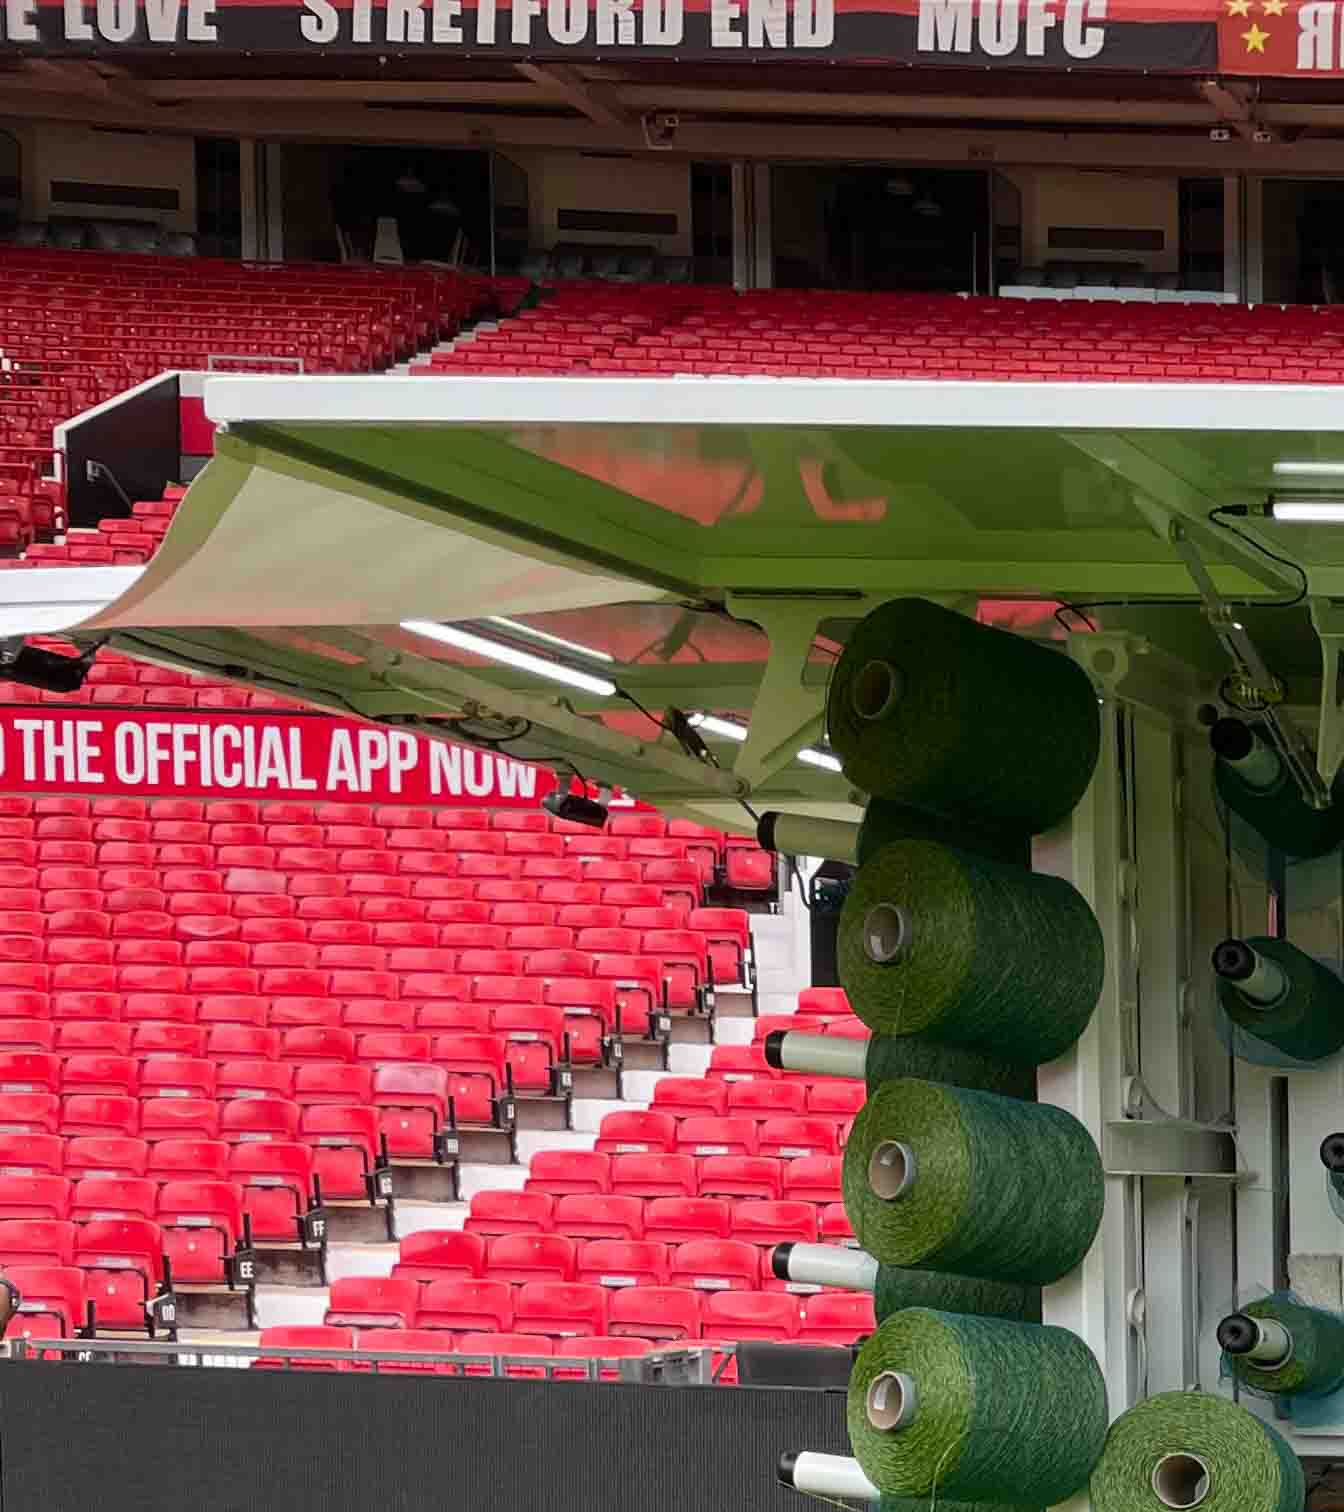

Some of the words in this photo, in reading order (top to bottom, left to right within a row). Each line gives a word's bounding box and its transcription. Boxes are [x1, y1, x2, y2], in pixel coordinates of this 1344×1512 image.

[64, 0, 217, 42] LOVE
[299, 0, 684, 47] STRETFORD
[711, 0, 835, 48] END
[917, 0, 1106, 58] MUFC
[13, 719, 105, 784] THE
[114, 720, 318, 791] OFFICIAL
[326, 727, 419, 794] APP
[428, 739, 537, 798] NOW
